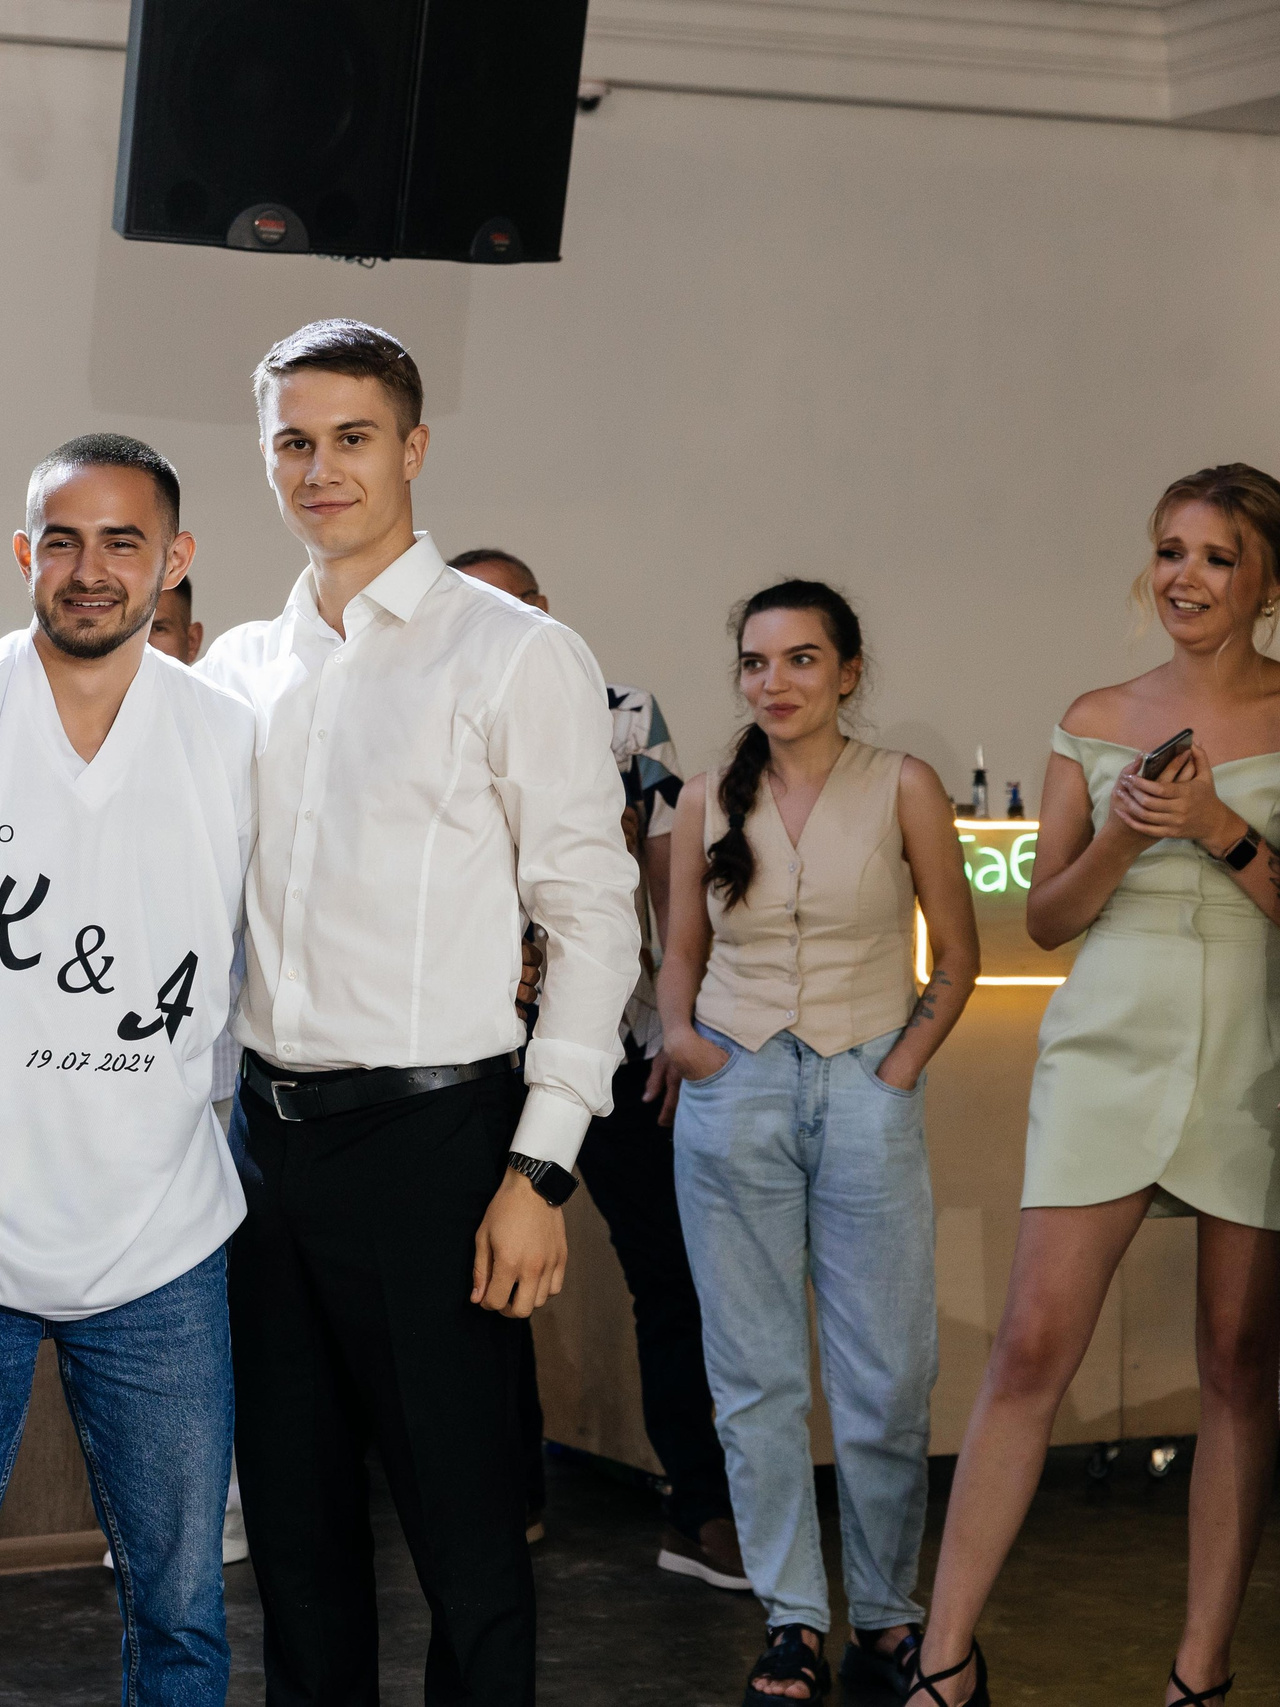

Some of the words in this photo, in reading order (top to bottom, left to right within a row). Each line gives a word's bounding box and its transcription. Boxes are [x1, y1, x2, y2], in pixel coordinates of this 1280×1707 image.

[57, 925, 115, 994] &
[117, 950, 198, 1044] A
[26, 1049, 155, 1072] 19.07.2024
